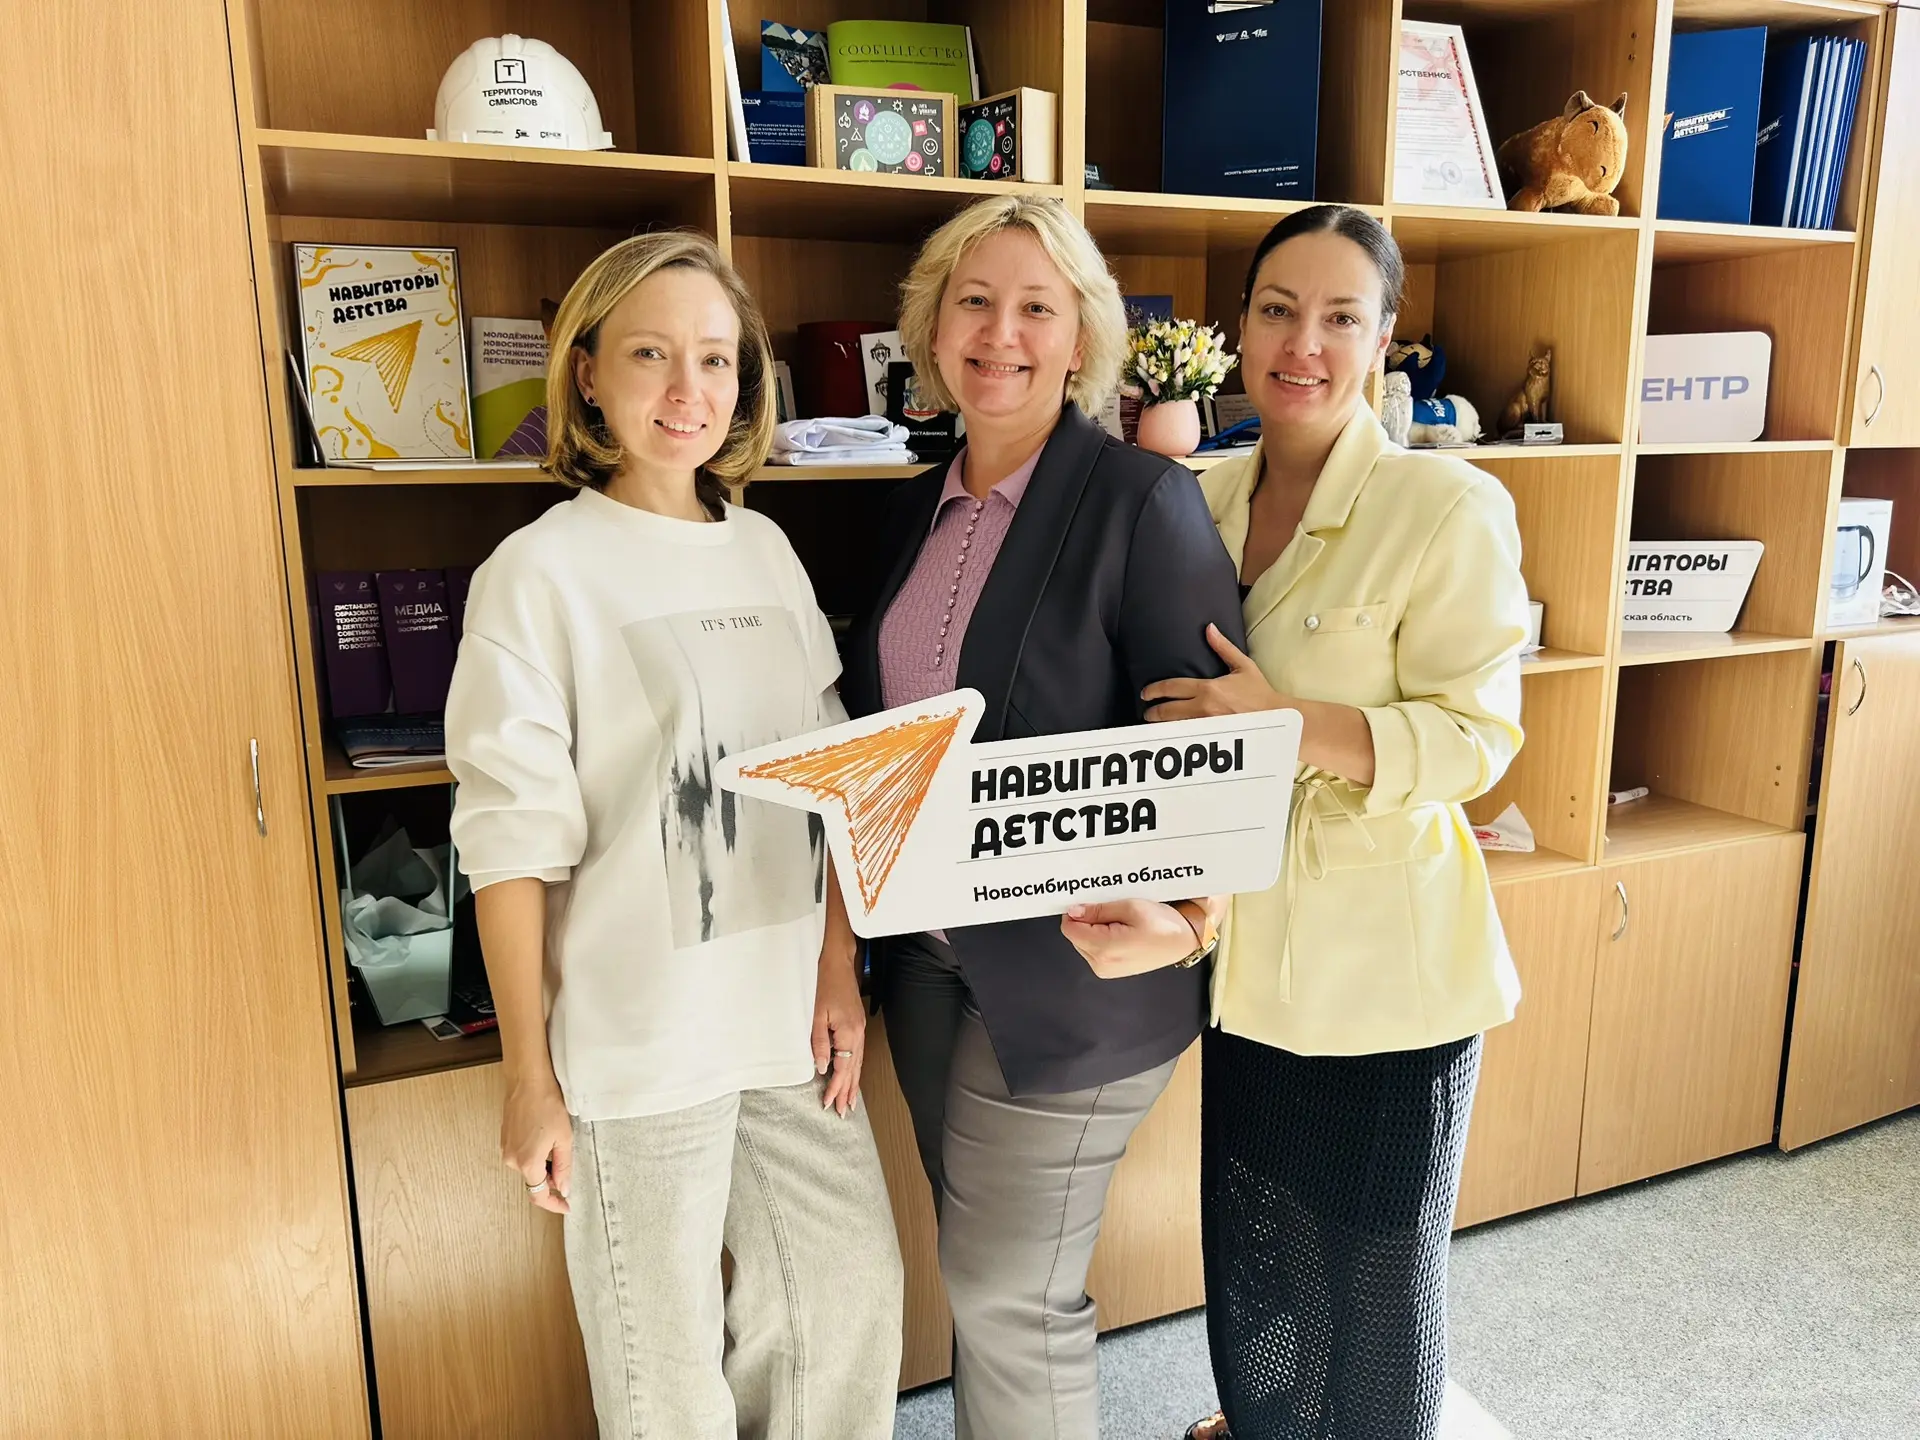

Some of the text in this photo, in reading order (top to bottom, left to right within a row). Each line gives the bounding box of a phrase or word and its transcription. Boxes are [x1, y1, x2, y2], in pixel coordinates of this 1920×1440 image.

[838, 44, 963, 59] СООБЩЕСТВО
[1399, 69, 1452, 80] РСТВЕННОЕ
[482, 88, 543, 97] ТЕРРИТОРИЯ
[488, 97, 538, 107] СМЫСЛОВ
[329, 273, 439, 302] НАВИГАТОРЫ
[333, 297, 408, 324] ДЕТСТВА
[1625, 579, 1673, 596] ТВА
[394, 603, 443, 616] МЕДИА
[1650, 612, 1693, 621] область
[700, 615, 762, 631] IT'S TIME
[971, 739, 1244, 804] НАВИГАТОРЫ
[971, 798, 1157, 859] ДЕТСТВА
[973, 864, 1204, 902] Новосибирская область
